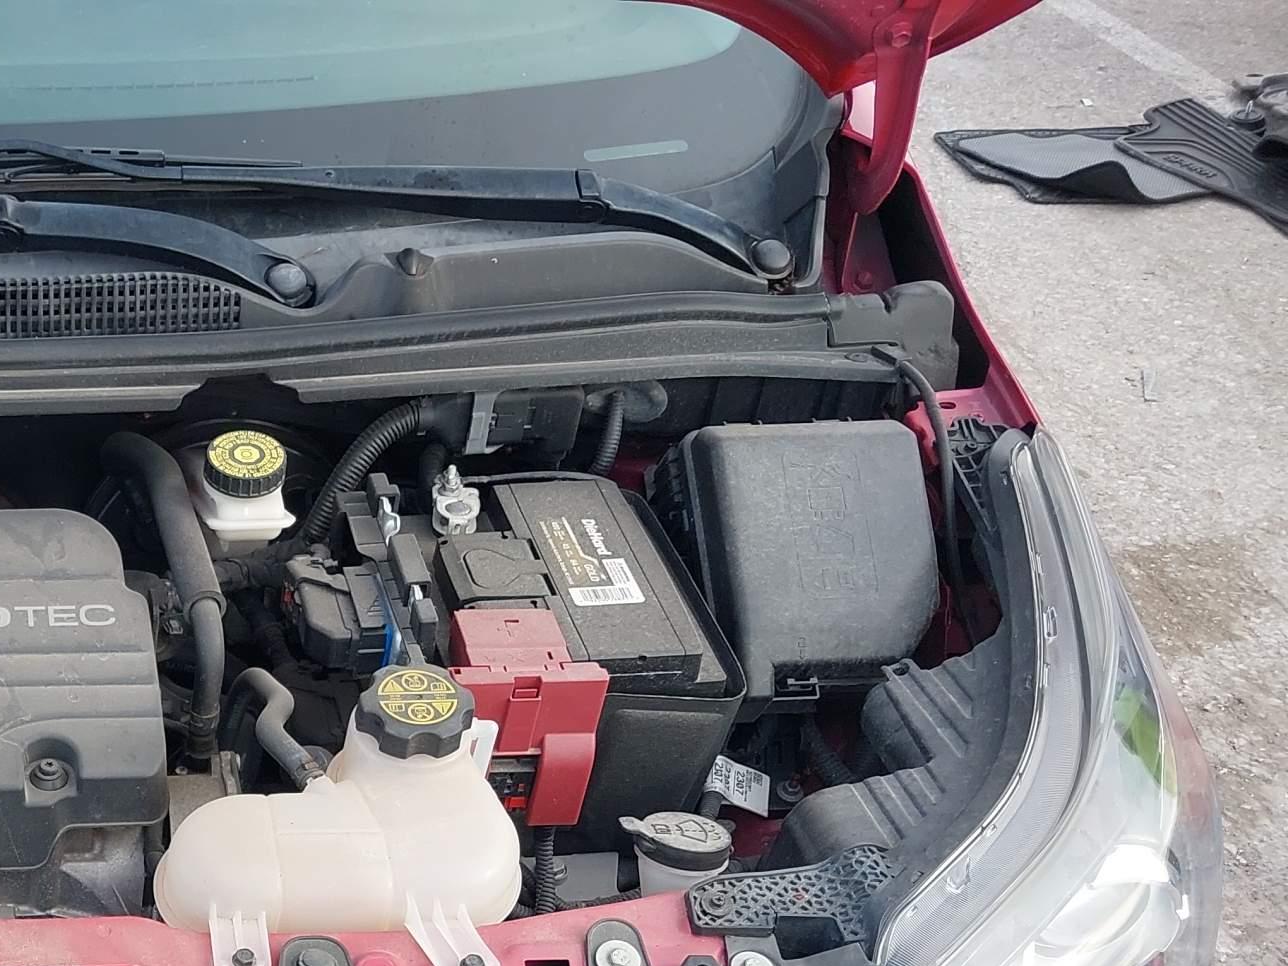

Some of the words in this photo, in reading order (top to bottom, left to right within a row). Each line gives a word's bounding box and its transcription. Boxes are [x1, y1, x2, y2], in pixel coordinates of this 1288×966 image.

[581, 518, 613, 556] DieHard
[583, 563, 601, 582] GOLD
[735, 770, 746, 796] 2307
